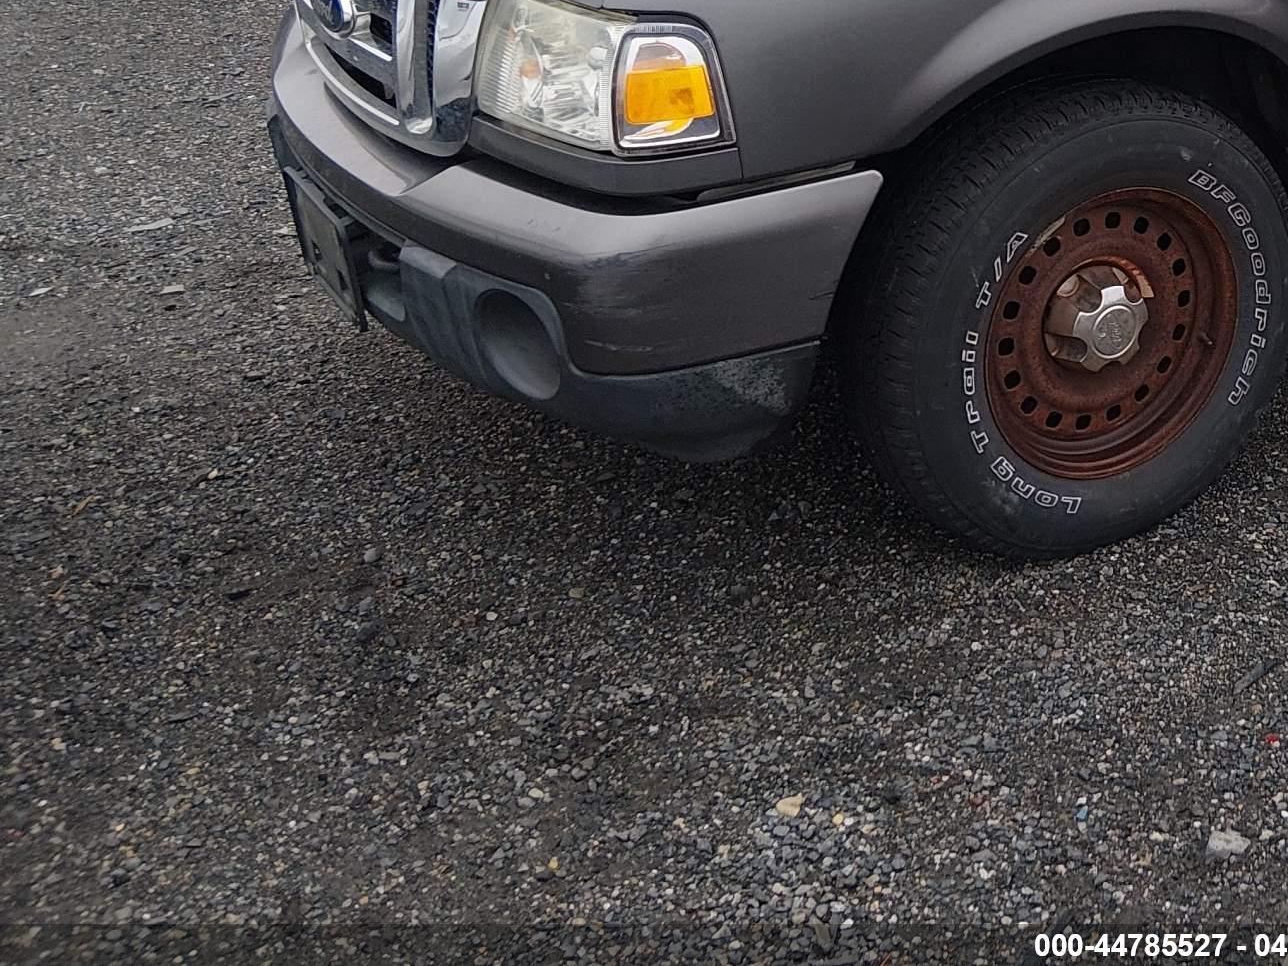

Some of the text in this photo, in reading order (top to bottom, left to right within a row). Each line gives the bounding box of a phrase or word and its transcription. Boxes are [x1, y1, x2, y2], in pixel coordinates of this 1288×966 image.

[1188, 169, 1272, 406] BFGoodrich
[961, 331, 989, 454] Trail
[990, 456, 1082, 514] Long
